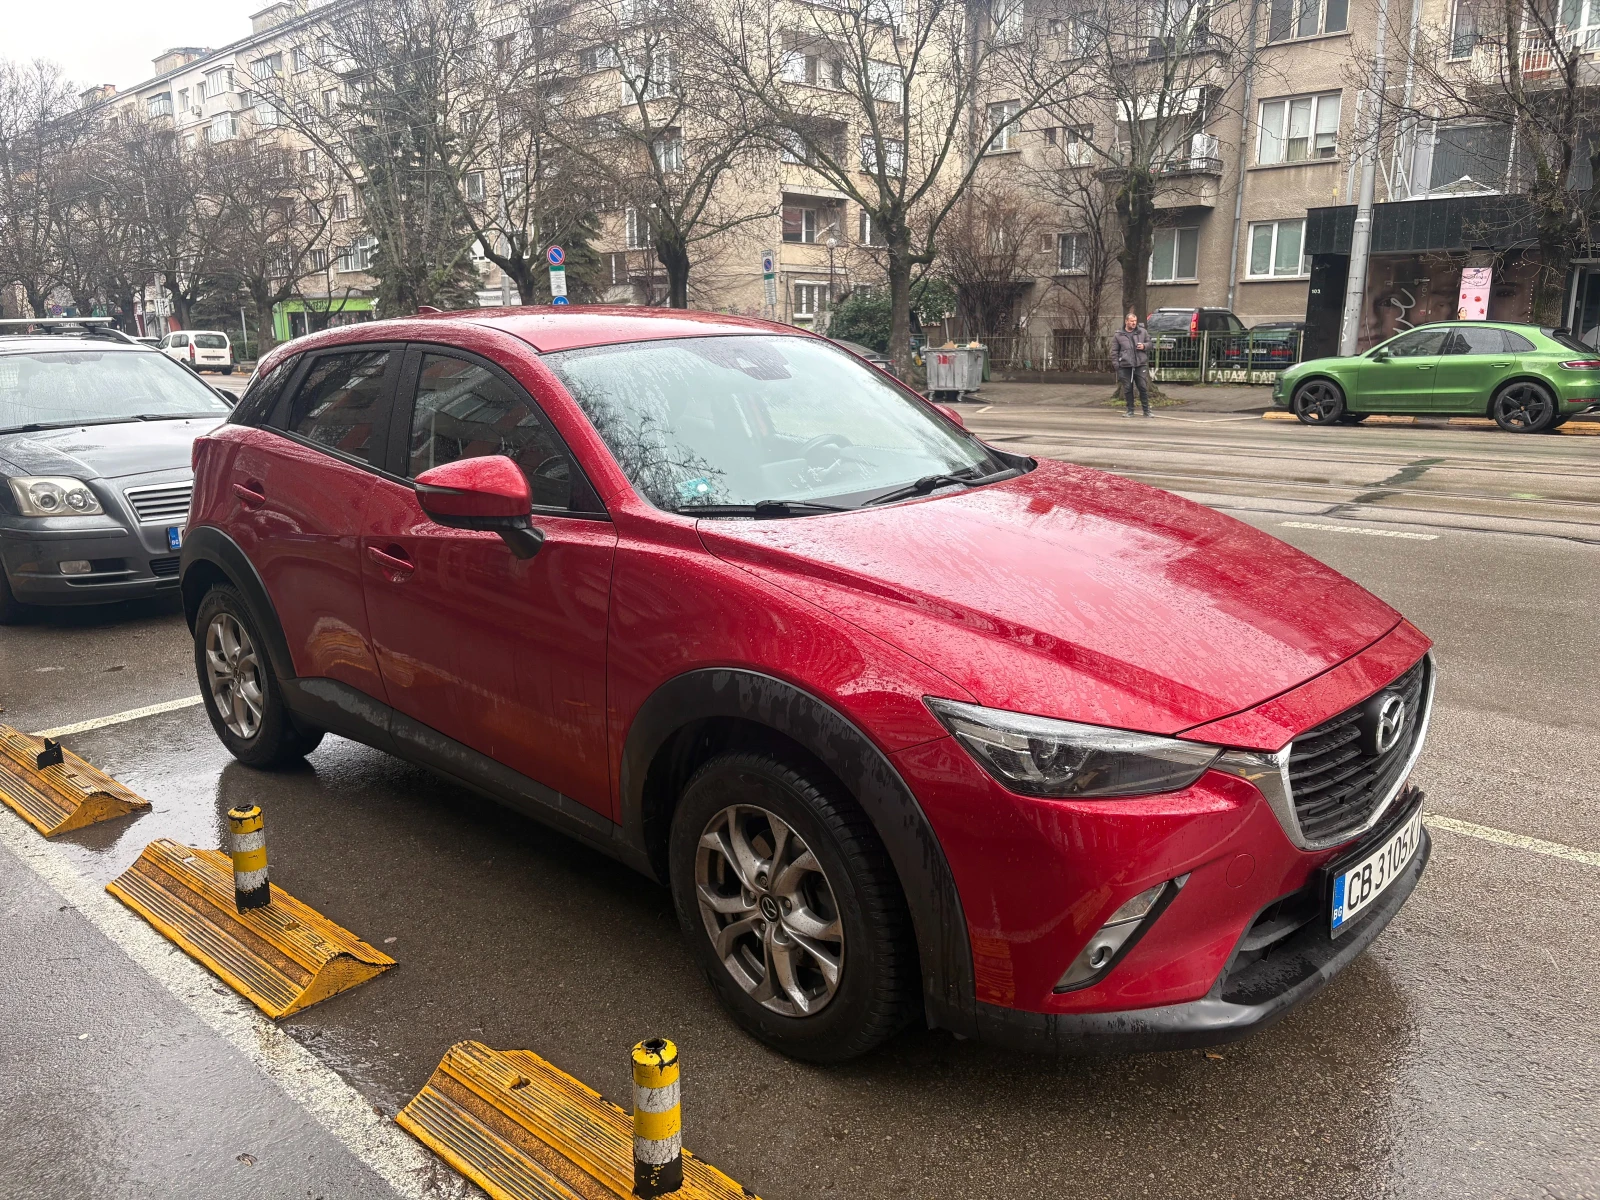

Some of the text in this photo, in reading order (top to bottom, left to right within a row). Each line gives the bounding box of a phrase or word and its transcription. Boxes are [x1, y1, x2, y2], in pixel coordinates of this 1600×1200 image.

[1208, 370, 1248, 382] ГАРАЖ
[1347, 862, 1373, 911] CB
[1375, 828, 1409, 890] 3105
[1333, 905, 1343, 920] BG
